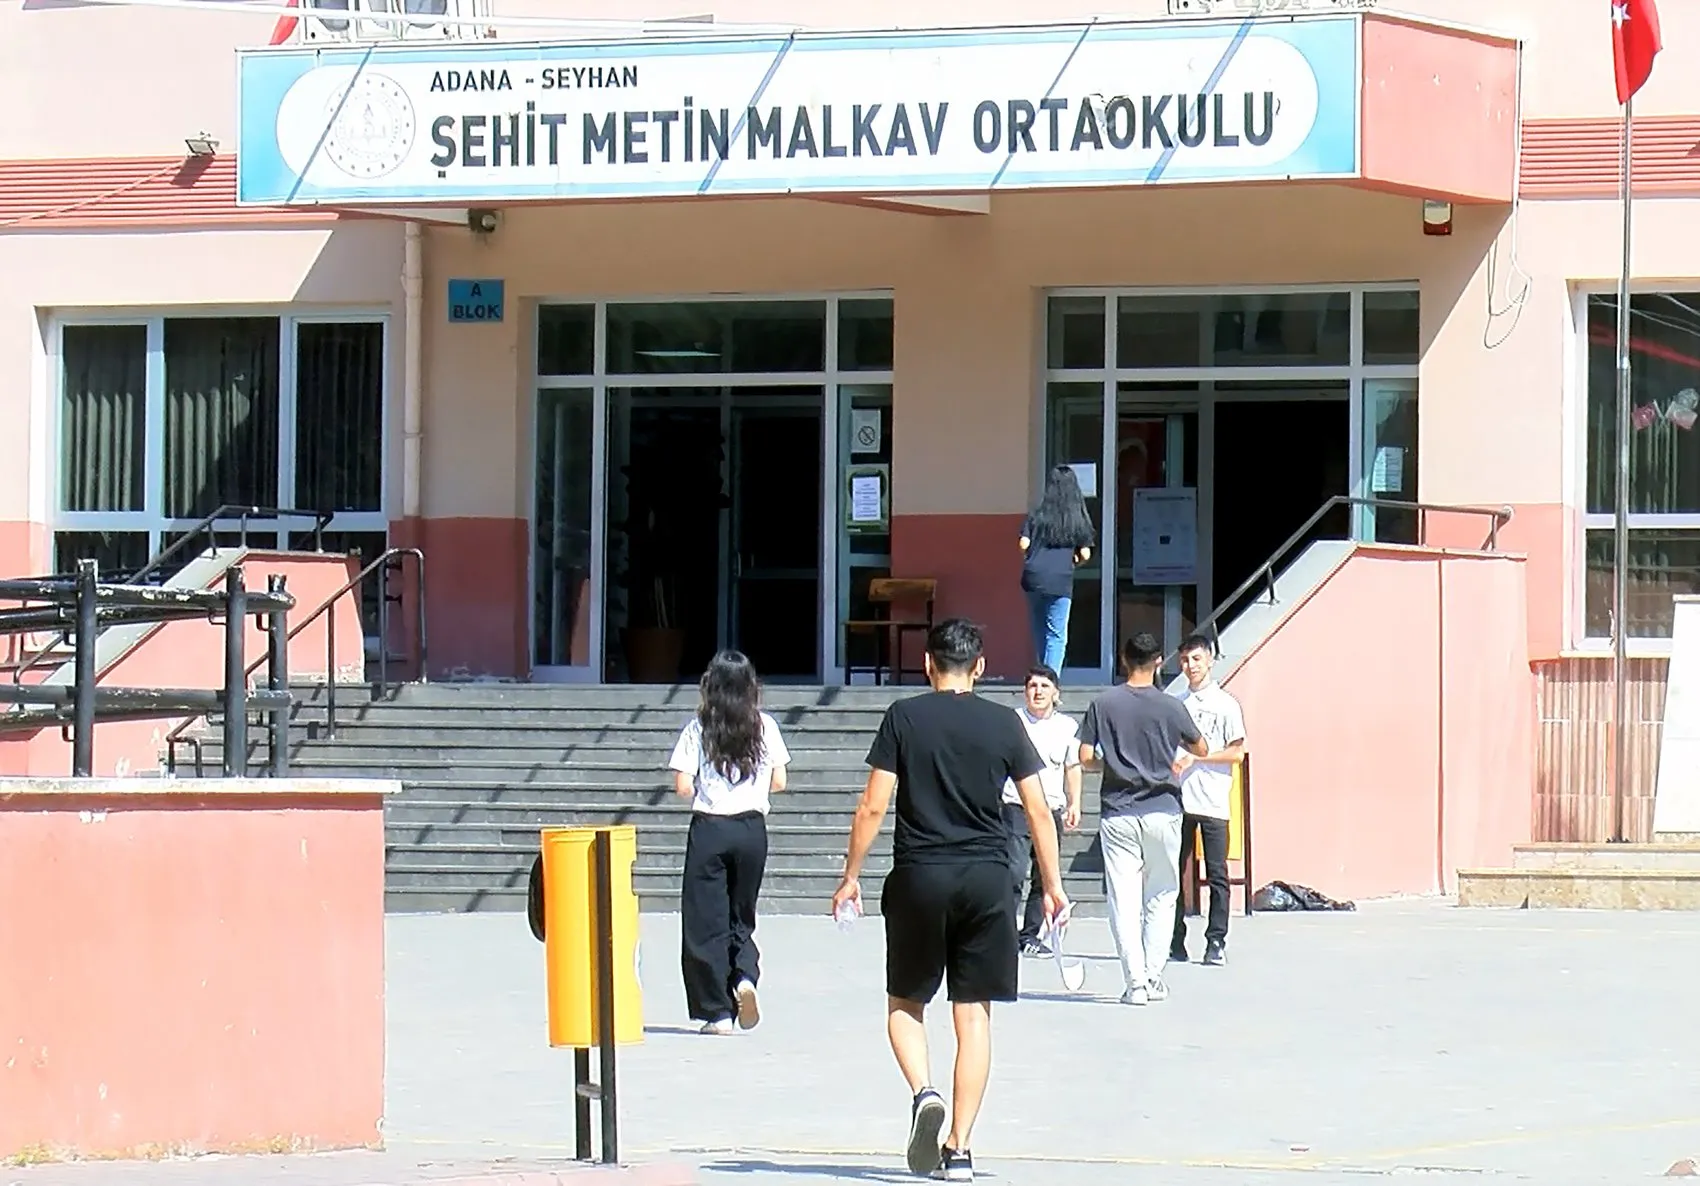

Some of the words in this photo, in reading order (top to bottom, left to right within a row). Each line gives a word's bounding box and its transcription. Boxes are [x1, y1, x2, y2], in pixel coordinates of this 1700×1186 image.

[430, 69, 514, 93] ADANA
[541, 65, 638, 90] SEYHAN
[430, 101, 567, 178] ŞEHİT
[582, 96, 729, 165] METİN
[747, 102, 949, 160] MALKAV
[973, 91, 1274, 154] ORTAOKULU
[470, 282, 482, 297] A
[453, 304, 501, 319] BLOK
